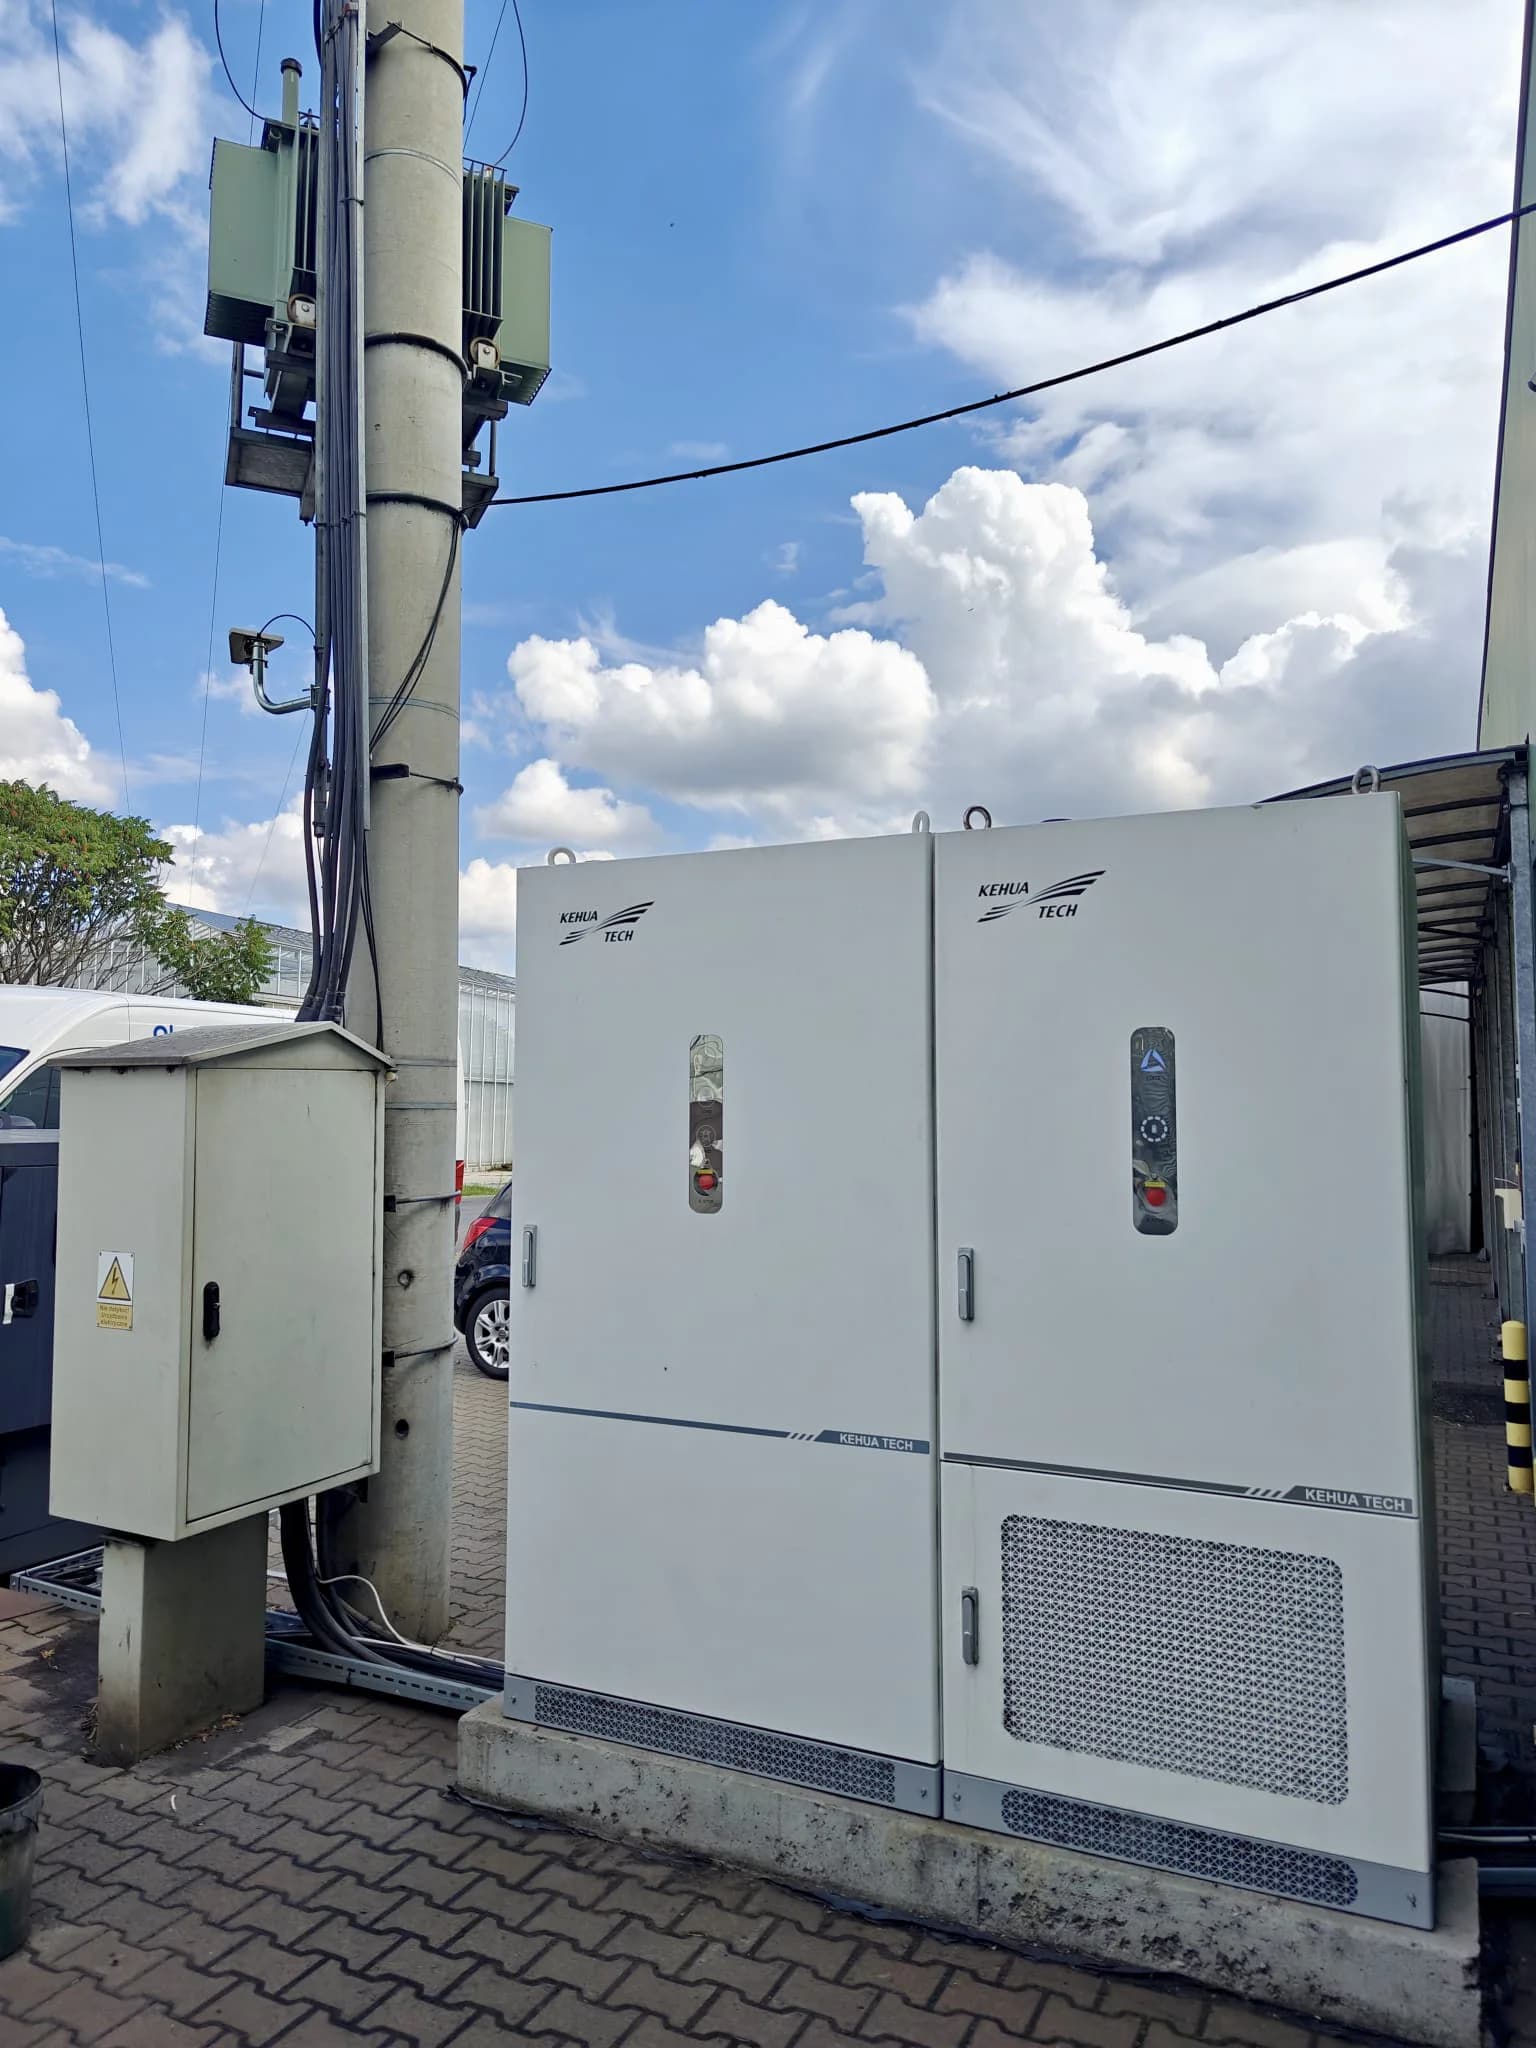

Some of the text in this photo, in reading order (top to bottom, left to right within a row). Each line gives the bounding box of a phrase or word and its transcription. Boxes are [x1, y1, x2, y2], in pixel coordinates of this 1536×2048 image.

[978, 881, 1029, 897] KEHUA
[560, 911, 598, 924] KEHUA
[1039, 904, 1078, 919] TECH
[605, 930, 634, 943] TECH
[840, 1433, 913, 1451] KEHUA TECH
[1305, 1488, 1405, 1512] KEHUA TECH
